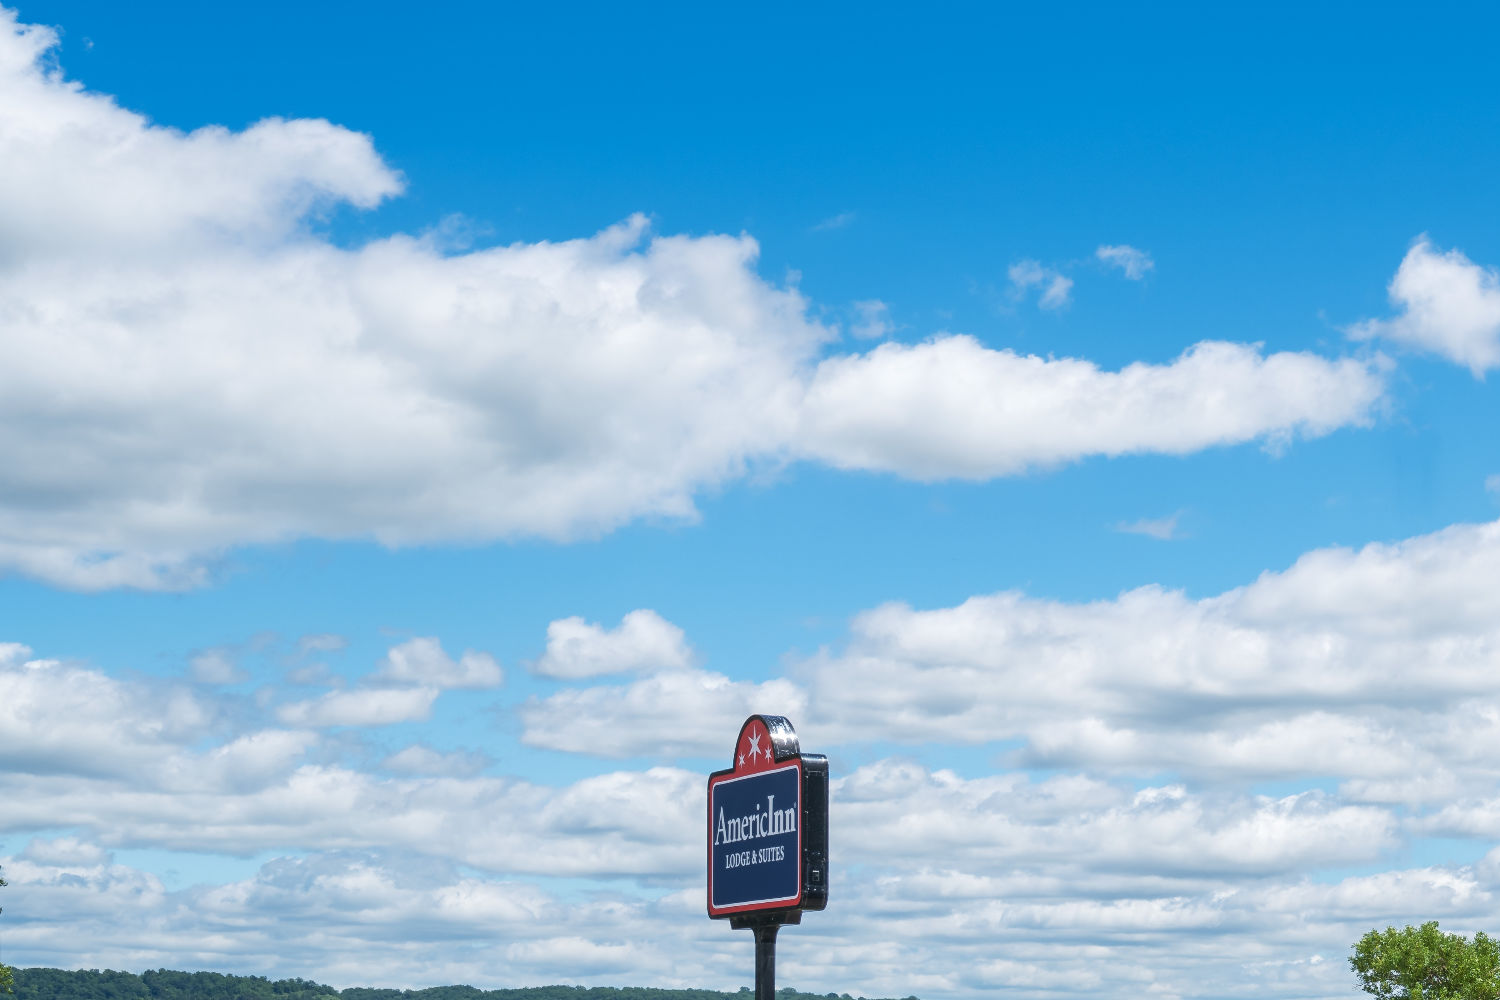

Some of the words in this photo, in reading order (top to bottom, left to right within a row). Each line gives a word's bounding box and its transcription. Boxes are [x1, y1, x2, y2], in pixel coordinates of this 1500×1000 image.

[714, 794, 796, 846] AmericInn
[725, 851, 751, 869] LODGE
[751, 849, 758, 865] &
[758, 845, 785, 864] SUITES
